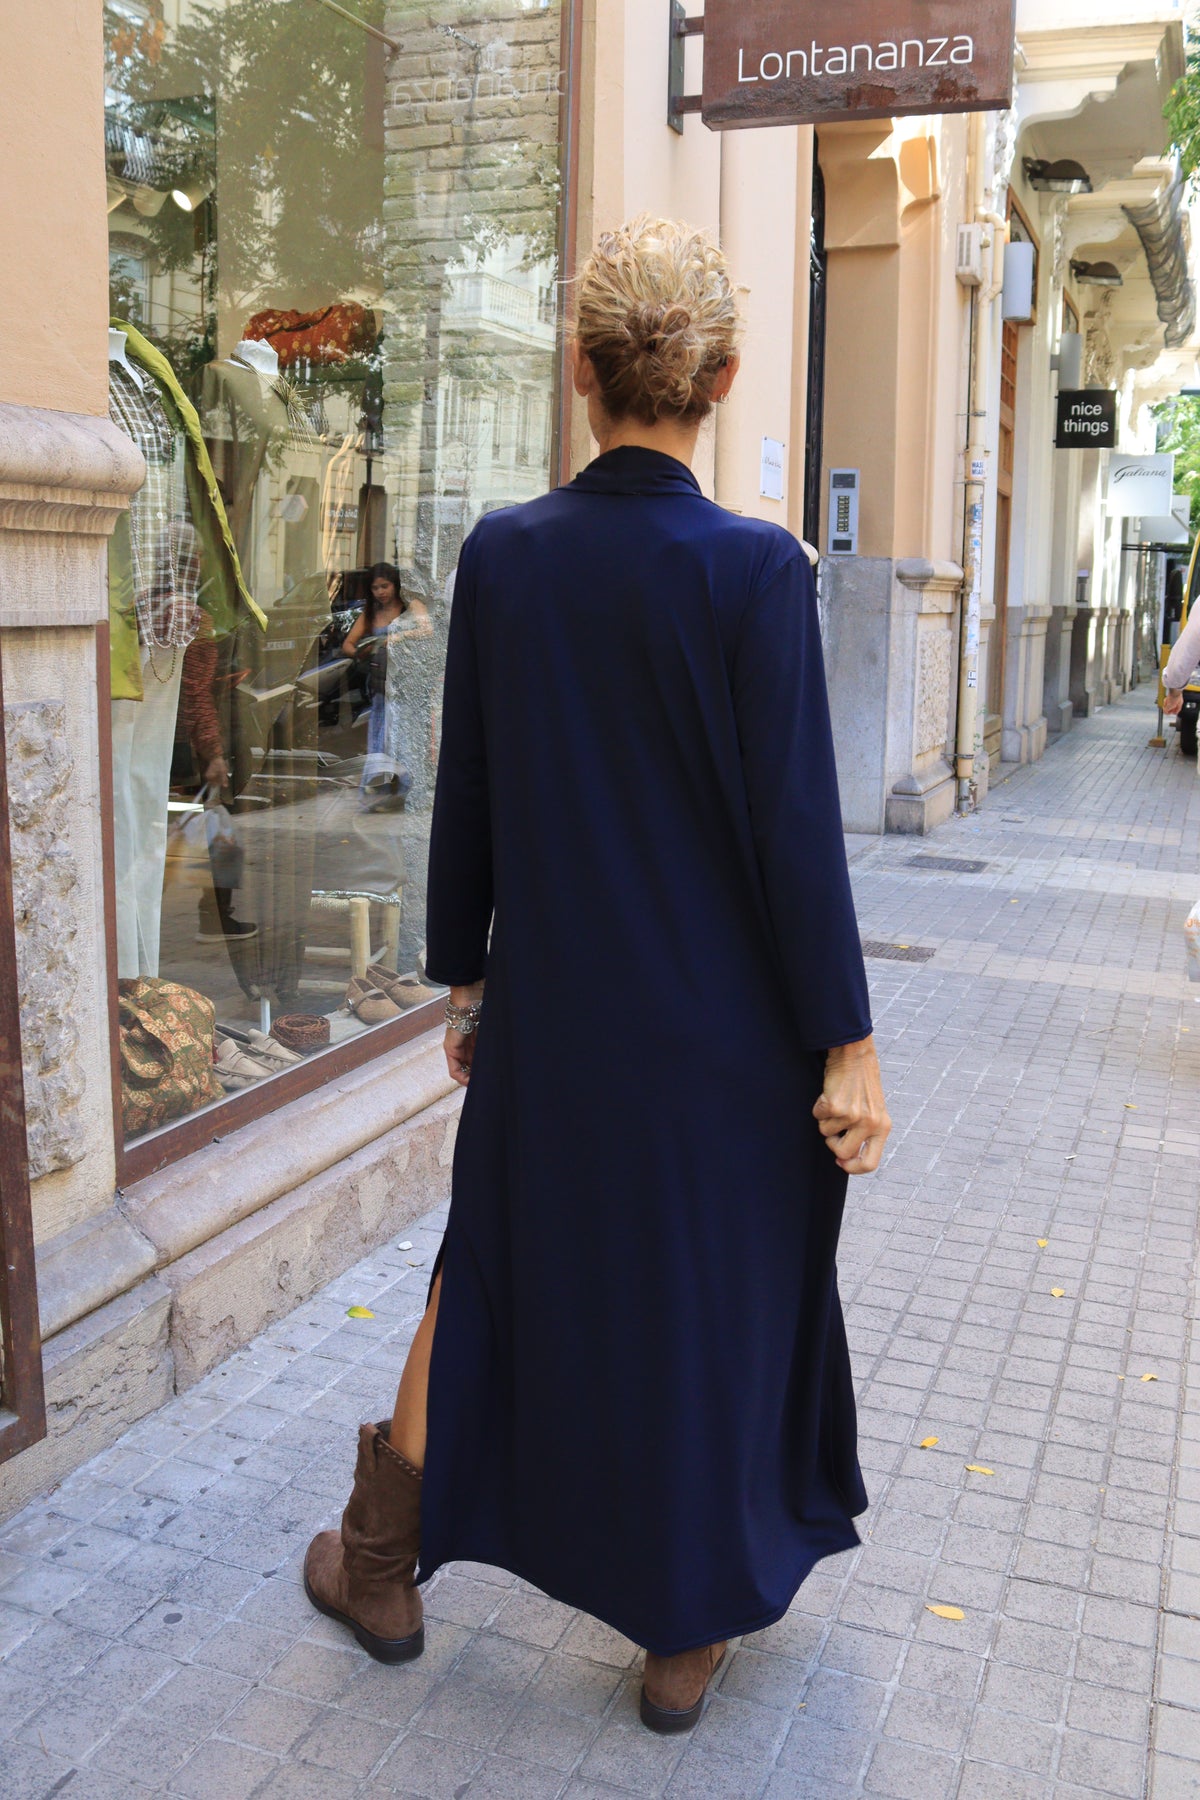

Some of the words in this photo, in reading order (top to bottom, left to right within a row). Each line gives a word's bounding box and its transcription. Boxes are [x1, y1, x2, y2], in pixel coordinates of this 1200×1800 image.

[738, 35, 974, 83] Lontananza
[1071, 401, 1102, 416] nice
[1064, 418, 1109, 436] things
[1113, 464, 1167, 484] Galiana
